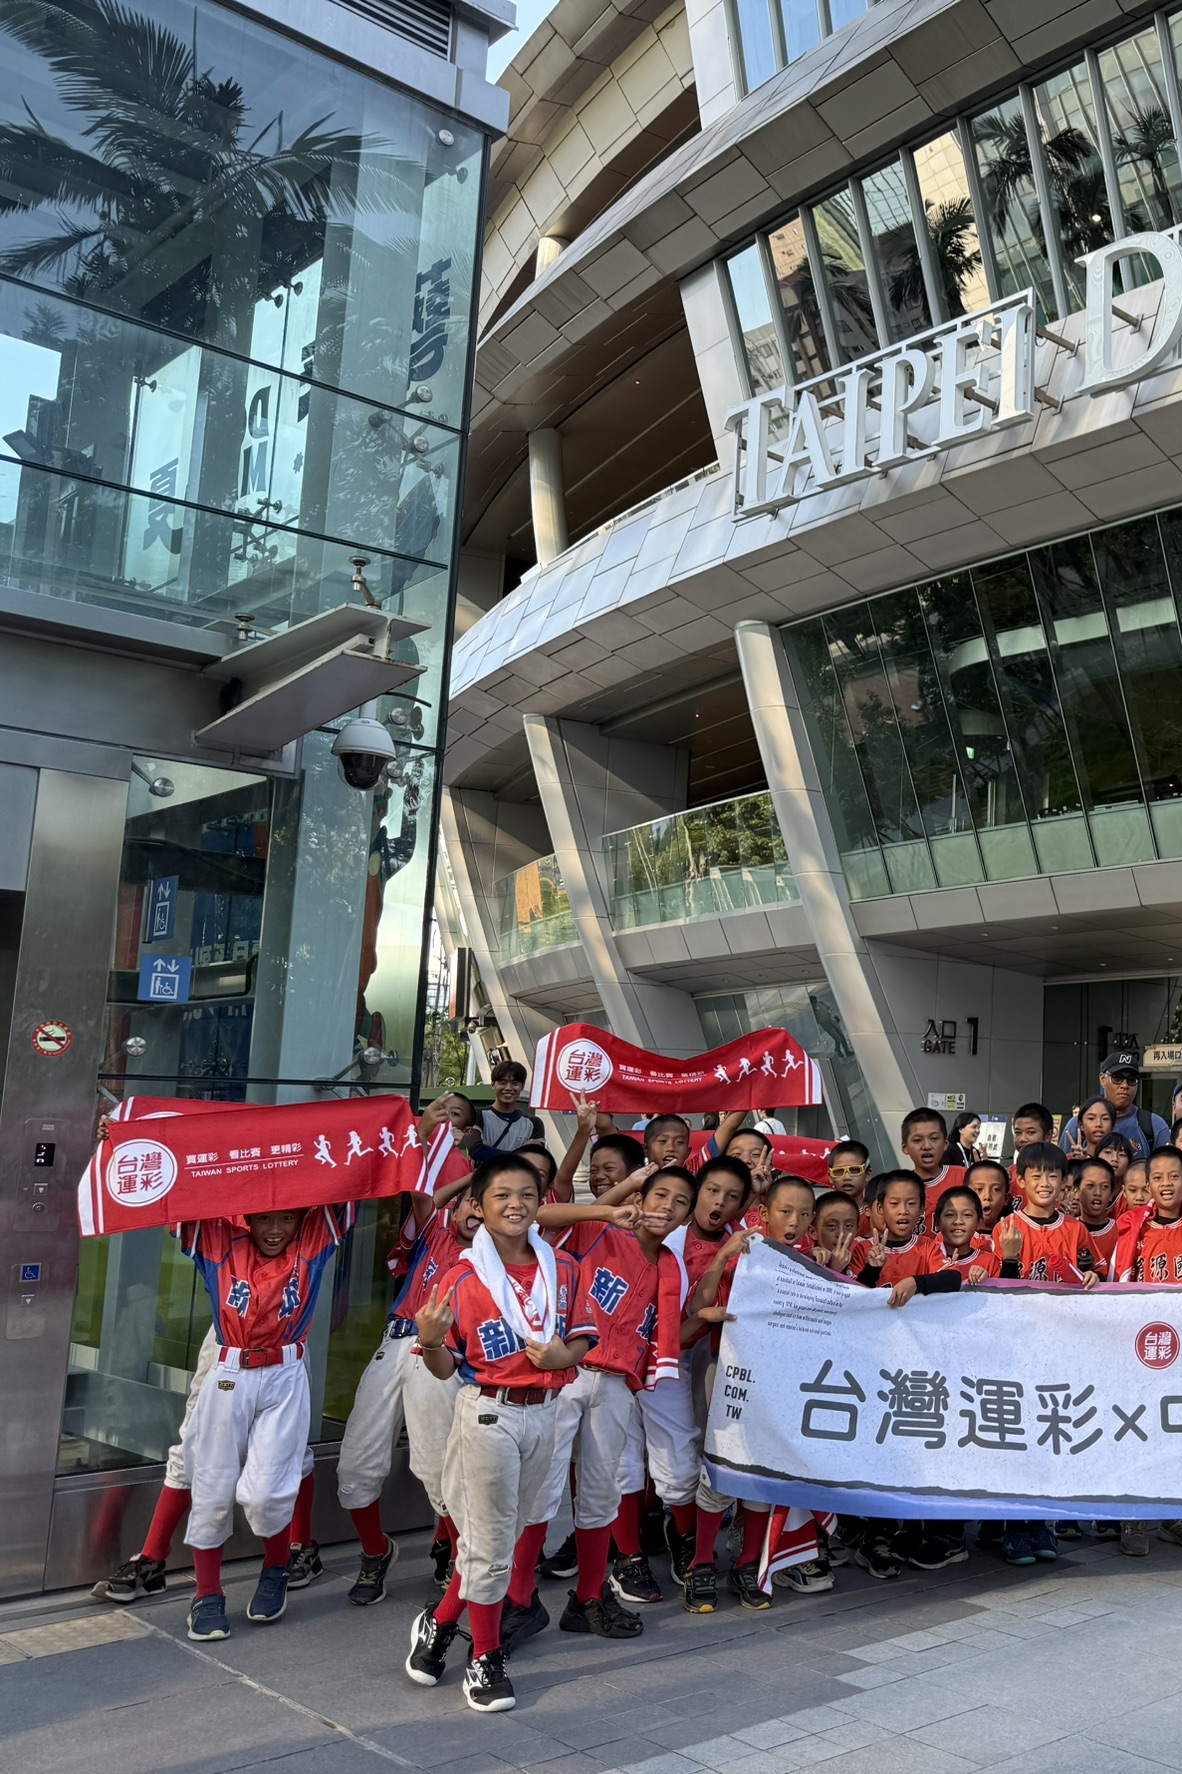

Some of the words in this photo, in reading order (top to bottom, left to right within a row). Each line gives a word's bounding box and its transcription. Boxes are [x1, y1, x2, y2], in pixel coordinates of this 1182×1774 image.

[724, 303, 1036, 519] TAIPEI
[922, 1018, 957, 1039] 入口
[922, 1039, 956, 1055] GATE
[568, 1049, 603, 1067] 台灣
[564, 1065, 601, 1082] 運彩
[117, 1152, 163, 1174] 台灣
[186, 1152, 219, 1165] 買運彩
[229, 1147, 261, 1160] 看比賽
[270, 1143, 302, 1156] 更精彩
[191, 1168, 222, 1178] TAIWAN
[226, 1163, 259, 1175] SPORTS
[262, 1159, 299, 1170] LOTTERY
[117, 1170, 164, 1196] 運彩
[1144, 1331, 1172, 1346] 台灣
[1143, 1345, 1172, 1361] 運彩
[725, 1365, 756, 1384] CPBL.
[724, 1385, 749, 1402] COM.
[726, 1404, 743, 1420] TW
